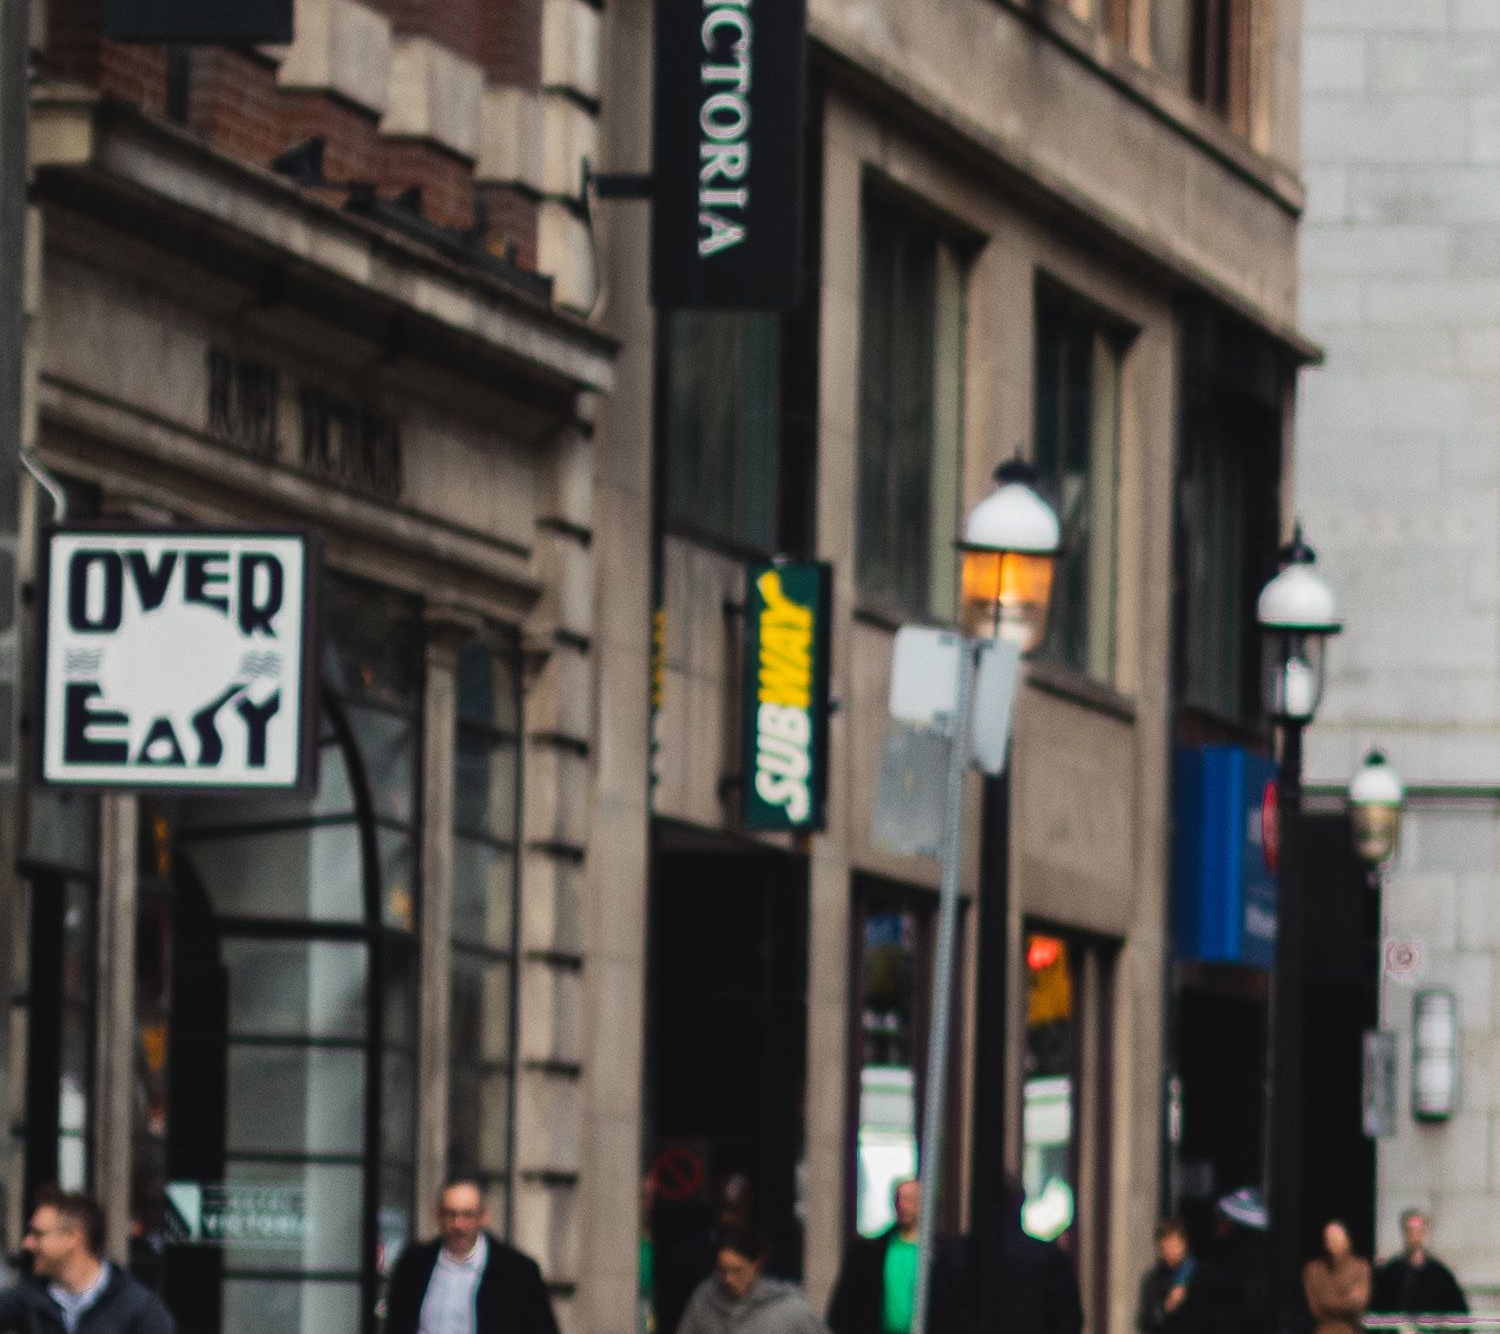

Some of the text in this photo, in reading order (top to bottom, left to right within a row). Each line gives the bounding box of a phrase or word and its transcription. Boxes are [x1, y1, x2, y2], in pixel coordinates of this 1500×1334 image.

[68, 549, 283, 637] OVER
[63, 682, 281, 768] EASY
[755, 570, 813, 823] SUBWAY
